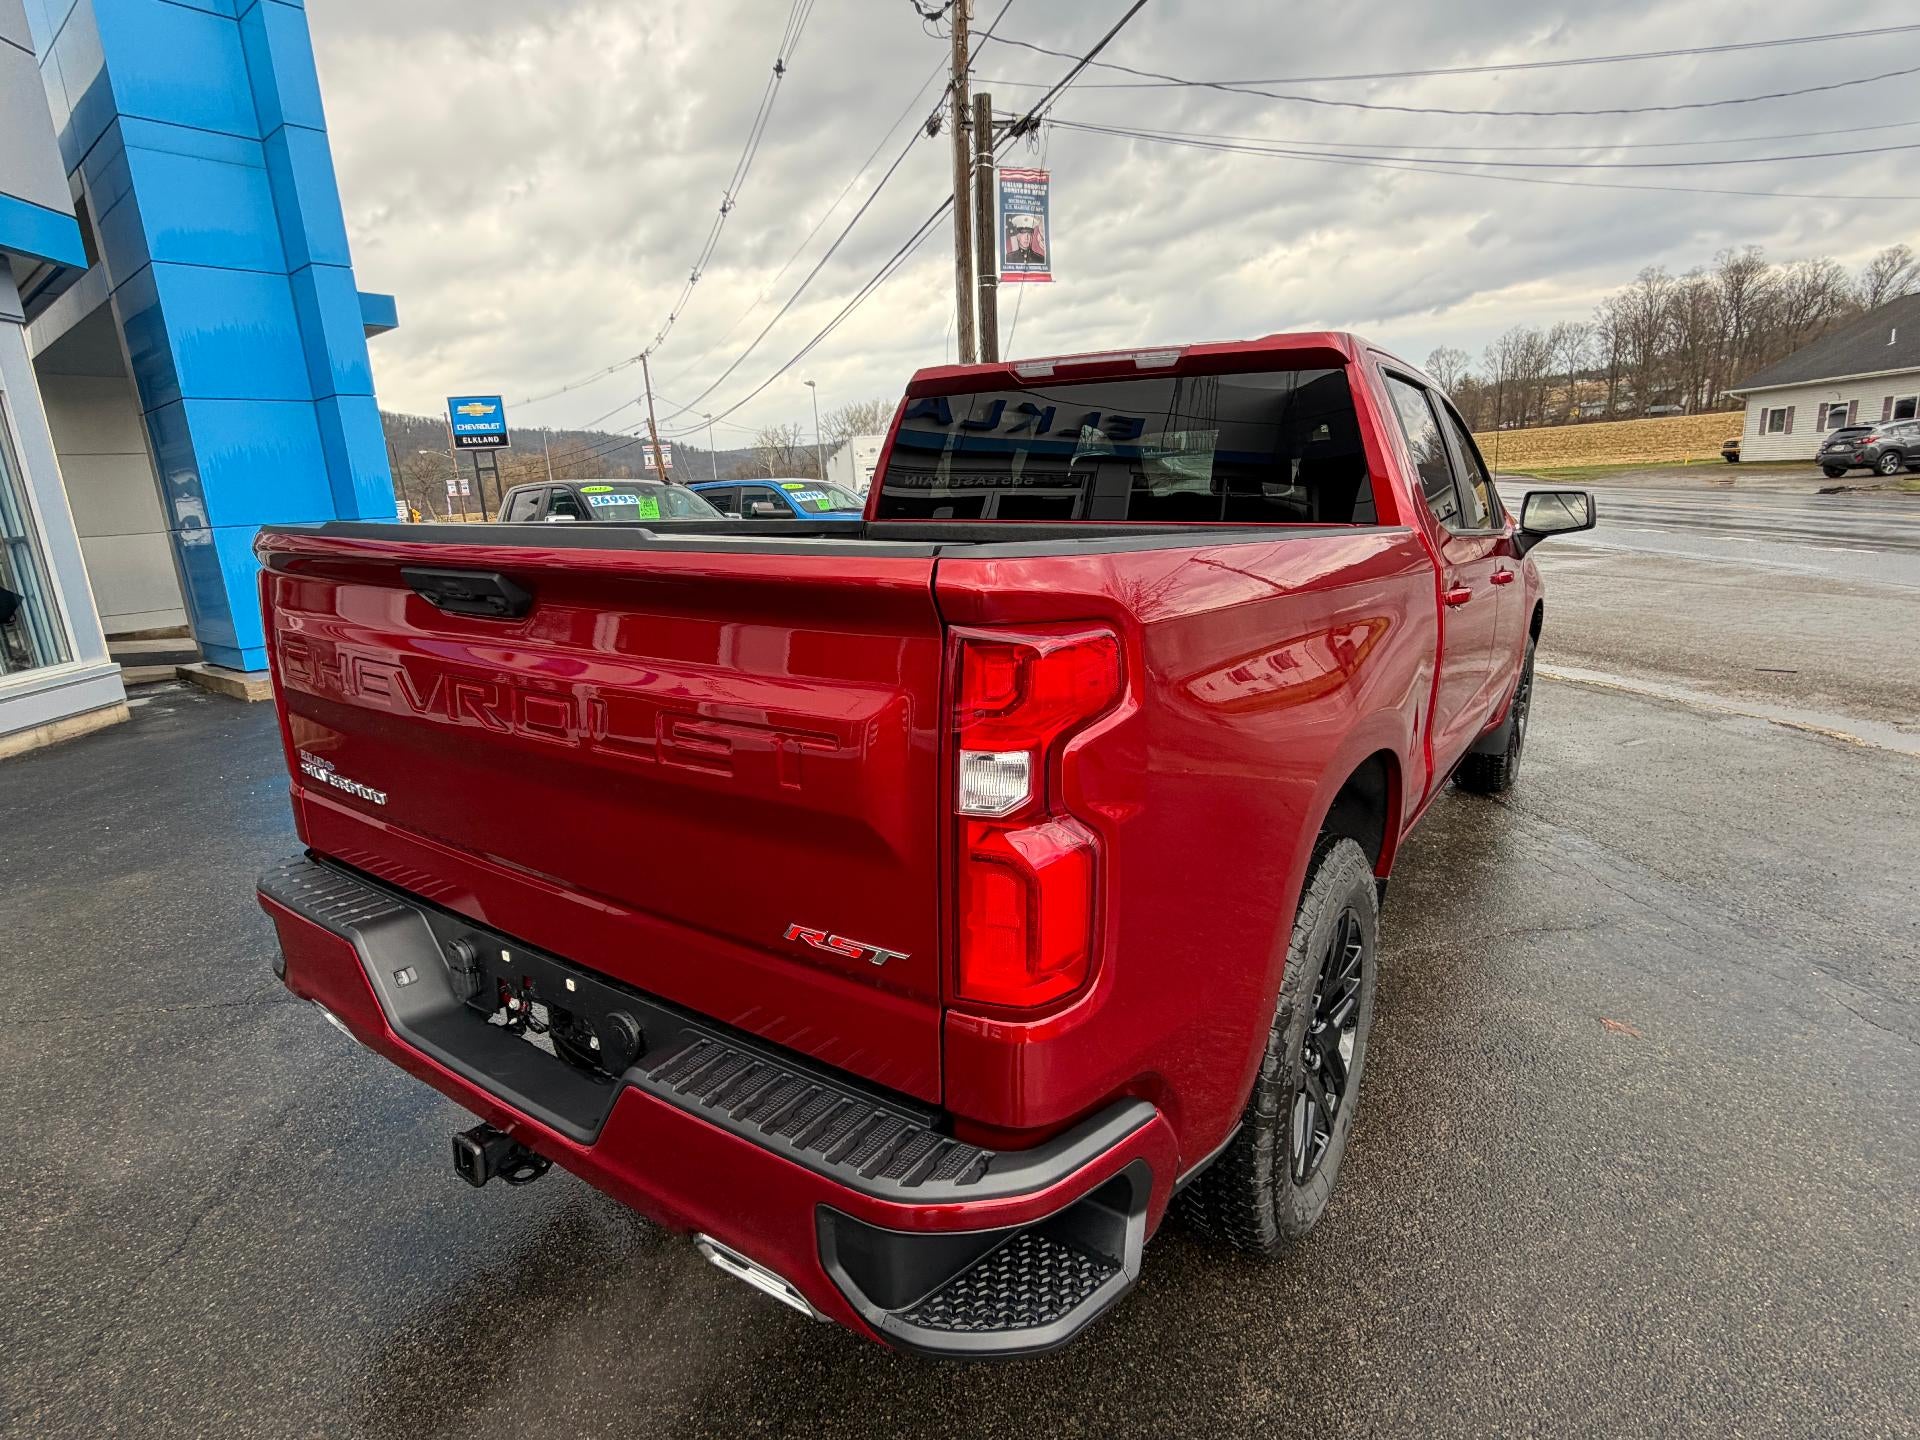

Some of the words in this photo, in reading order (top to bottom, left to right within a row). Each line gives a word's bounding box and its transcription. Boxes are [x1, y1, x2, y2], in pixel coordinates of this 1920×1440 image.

[457, 422, 501, 431] CHEVROLET
[462, 436, 500, 444] ELKLAND
[591, 495, 638, 506] 36995
[282, 636, 842, 790] CHEVROLET
[783, 922, 912, 966] RST
